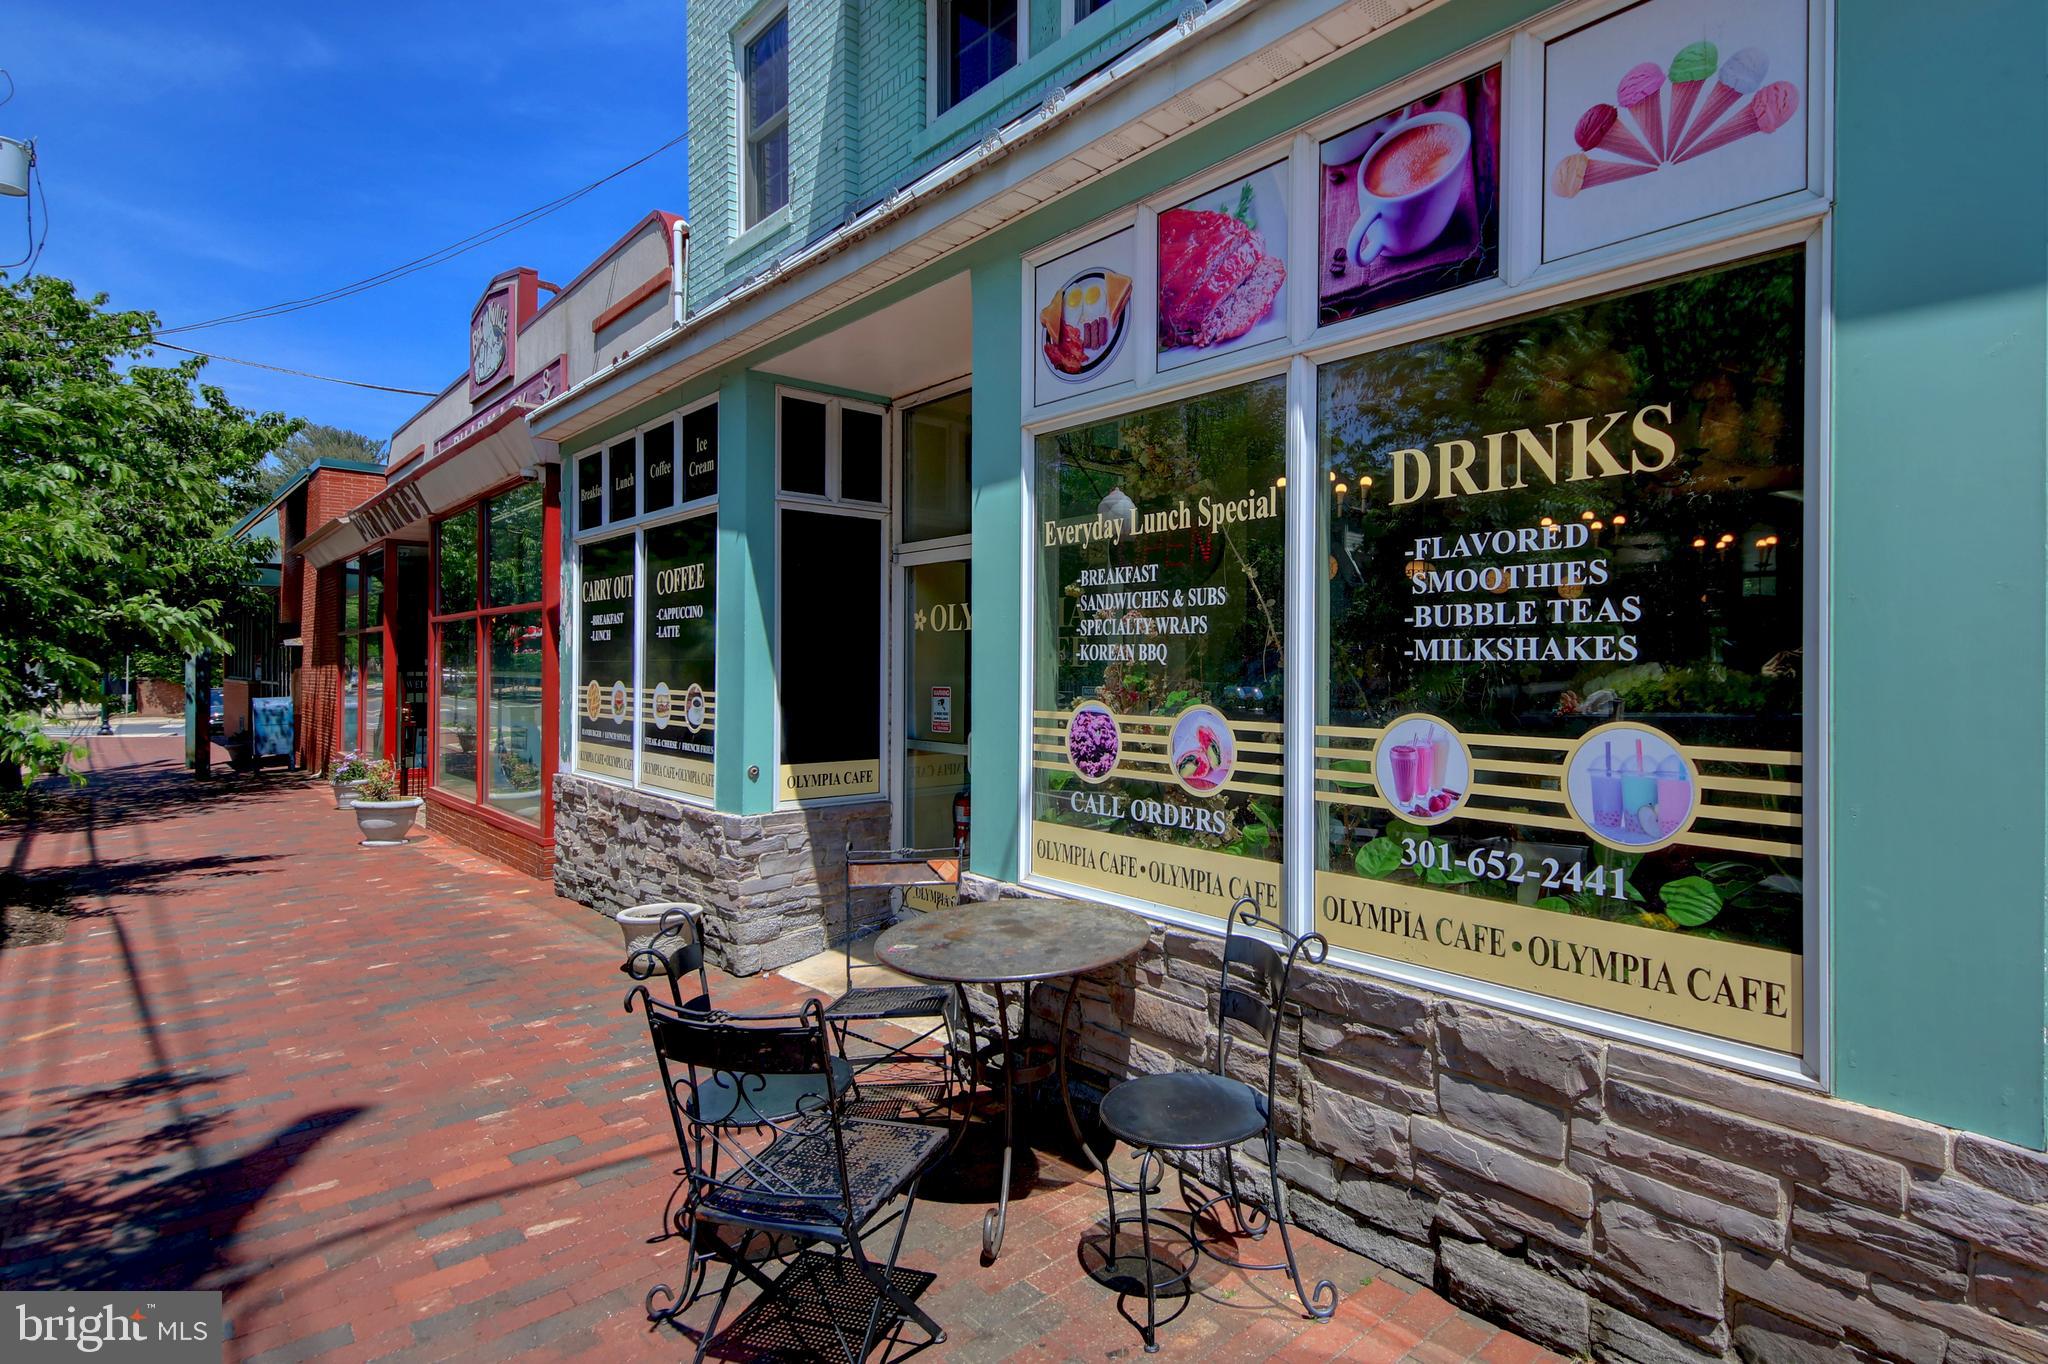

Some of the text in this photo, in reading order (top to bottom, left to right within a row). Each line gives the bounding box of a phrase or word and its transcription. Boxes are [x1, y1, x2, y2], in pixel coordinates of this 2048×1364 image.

[696, 438, 708, 453] Ice
[1388, 401, 1677, 506] DRINKS
[650, 460, 672, 479] Coffee
[689, 459, 715, 477] Cream
[615, 473, 635, 491] Lunch
[1045, 486, 1278, 549] Everyday Lunch Special
[1404, 522, 1589, 561] -FLAVORED
[656, 563, 705, 595] COFFEE
[1076, 564, 1158, 587] -BREAKFAST
[1411, 558, 1609, 597] SMOOTHIES
[583, 575, 633, 602] CARRY OUT
[1076, 586, 1226, 612] -SANDWICHES & SUBS
[591, 613, 624, 626] -BREAKFAST
[656, 605, 704, 620] -CAPPUCCINO
[1404, 595, 1642, 628] -BUBBLE TEAS
[591, 630, 612, 641] -LUNCH
[656, 625, 681, 638] -LATTE
[1075, 615, 1208, 637] -SPECIALTY WRAPS
[1075, 643, 1168, 665] -KOREAN BBQ
[1403, 634, 1640, 662] -MILKSHAKES
[645, 737, 658, 748] STEAK
[662, 740, 678, 750] CHEESE
[682, 742, 700, 753] FRENCH
[643, 762, 662, 776] OLYMPIA
[663, 766, 676, 779] CAFE
[678, 768, 700, 784] OLYMPIA
[787, 765, 873, 789] OLYMPIA CAFE
[1070, 791, 1226, 835] CALL ORDERS
[1036, 838, 1278, 909] OLYMPIA CAFE OLYMPIA CAFE
[1400, 837, 1629, 901] 301-652-2441
[1322, 895, 1788, 1019] OLYMPIA CAFE OLYMPIA CAFE
